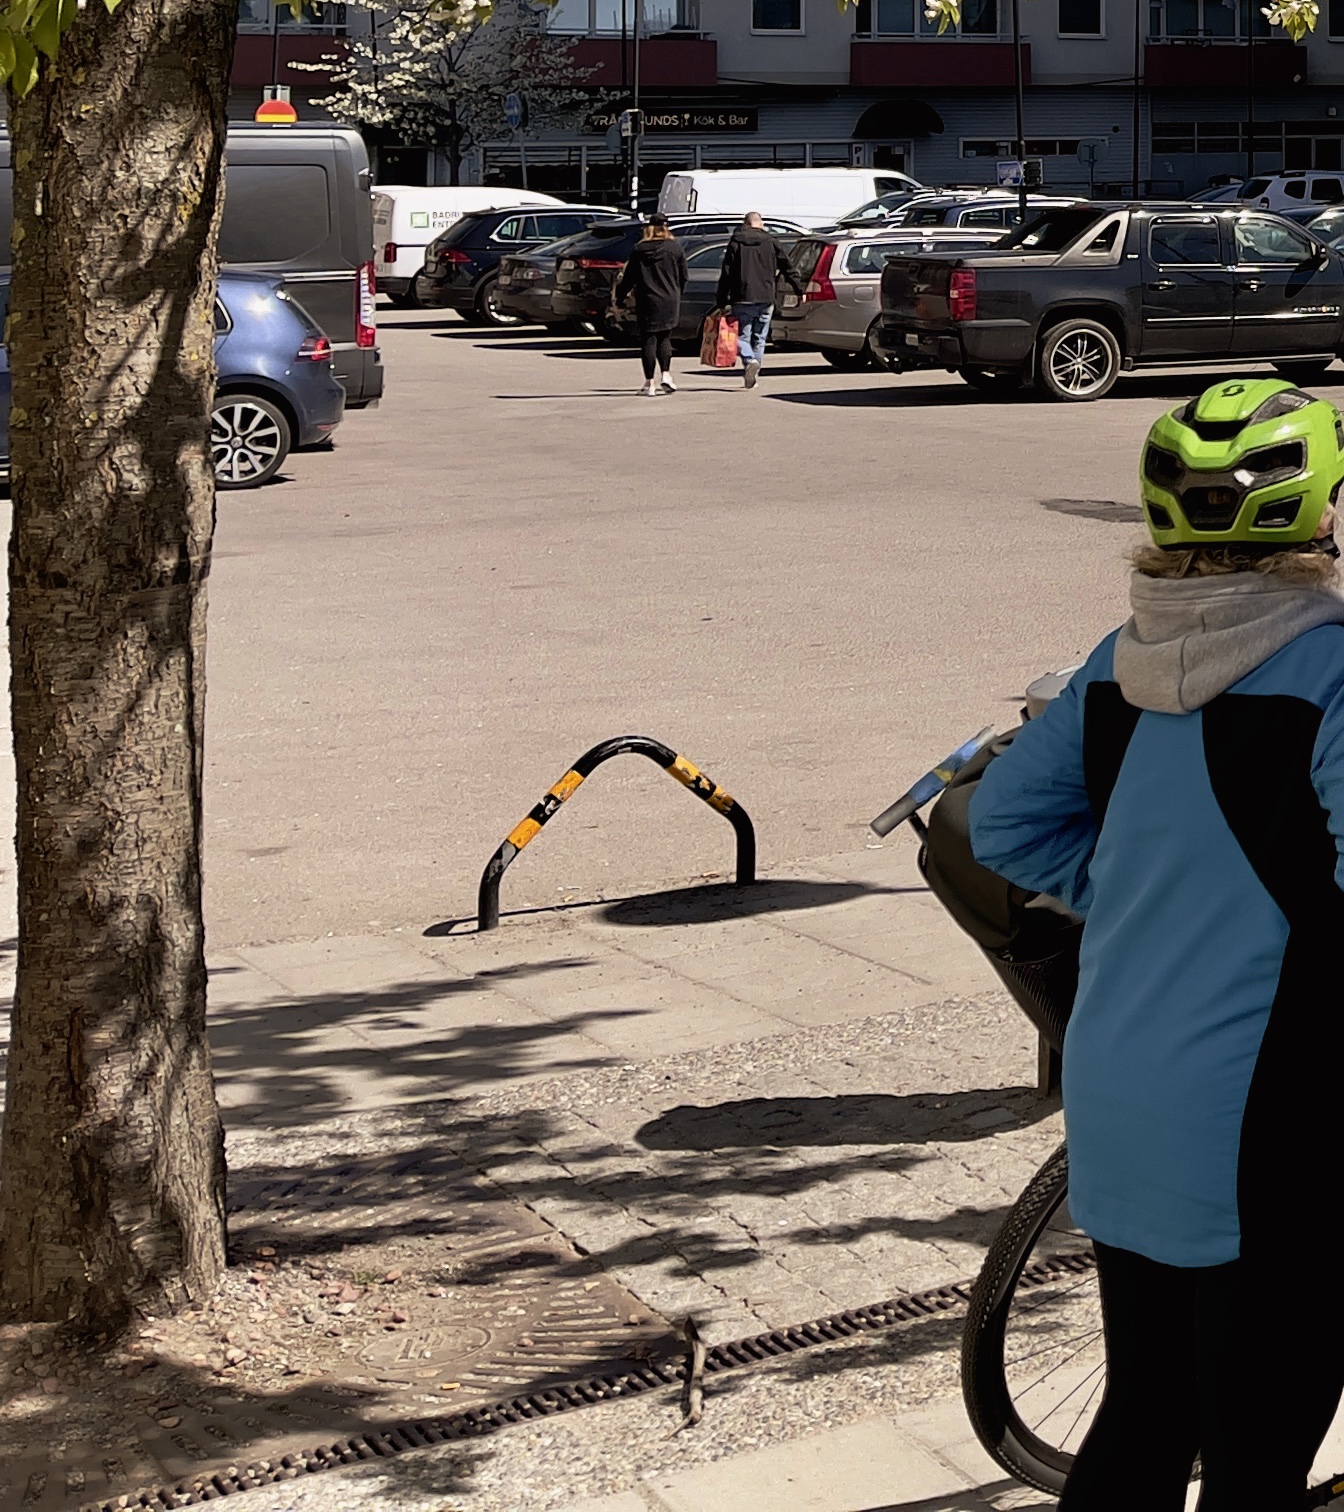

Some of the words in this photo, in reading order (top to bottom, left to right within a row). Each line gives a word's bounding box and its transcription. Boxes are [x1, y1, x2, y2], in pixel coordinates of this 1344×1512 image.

[693, 114, 715, 126] Kök
[717, 114, 726, 126] &
[729, 114, 749, 126] Bar
